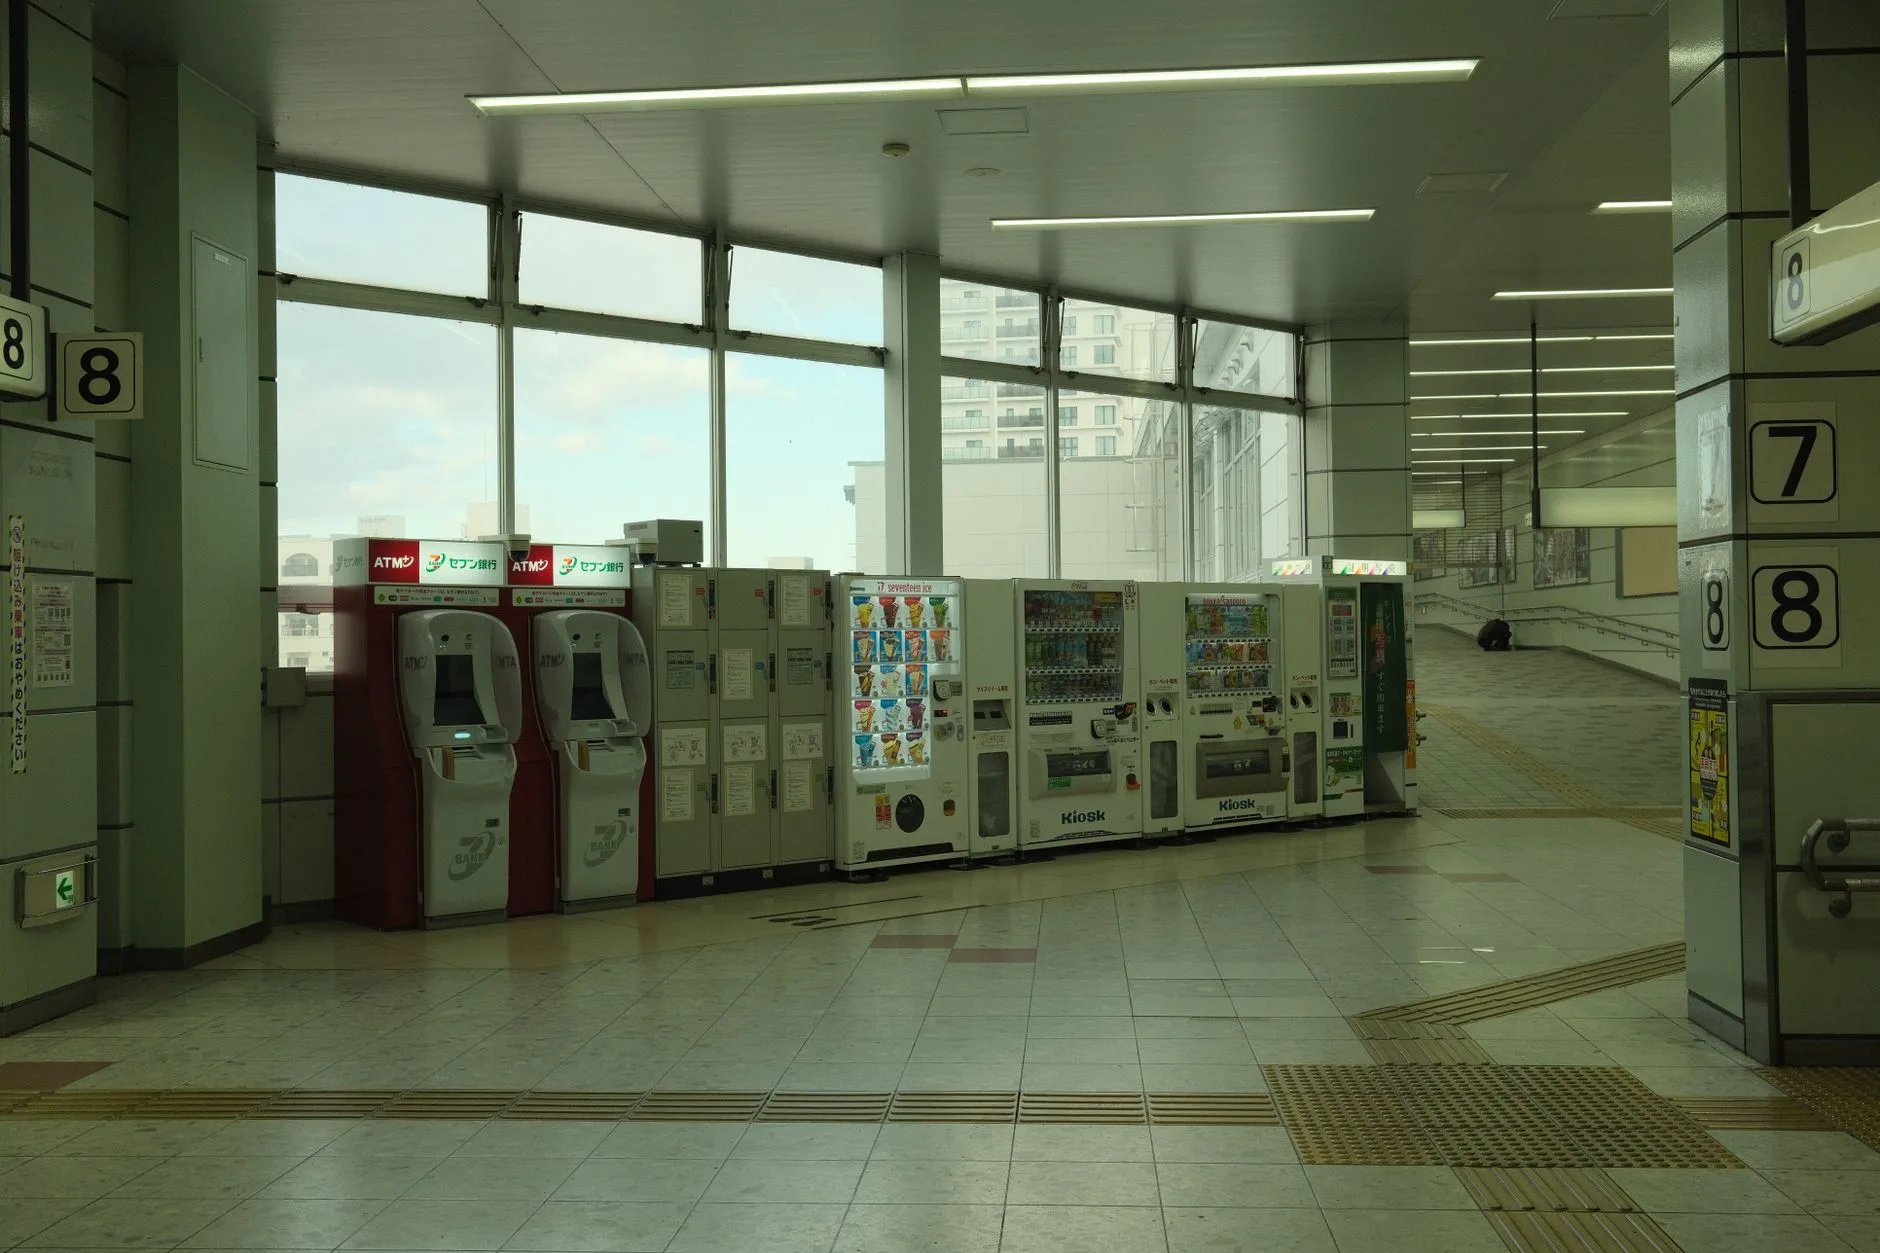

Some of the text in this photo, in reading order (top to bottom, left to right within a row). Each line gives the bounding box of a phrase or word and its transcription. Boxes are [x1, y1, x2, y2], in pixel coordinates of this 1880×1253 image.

[1786, 252, 1804, 311] 8
[3, 318, 25, 370] 8
[78, 347, 121, 405] 8
[1768, 426, 1818, 497] 7
[374, 555, 406, 569] ATM
[449, 558, 497, 570] セブン銀行
[512, 559, 539, 572] ATM
[580, 560, 624, 573] セブン銀行
[888, 583, 921, 593] seventeen
[922, 582, 932, 592] ice
[1707, 573, 1723, 644] 8
[1770, 570, 1823, 643] 8
[1219, 798, 1255, 811] Kiosk
[1061, 810, 1105, 824] Kiosk
[455, 852, 485, 864] BANK
